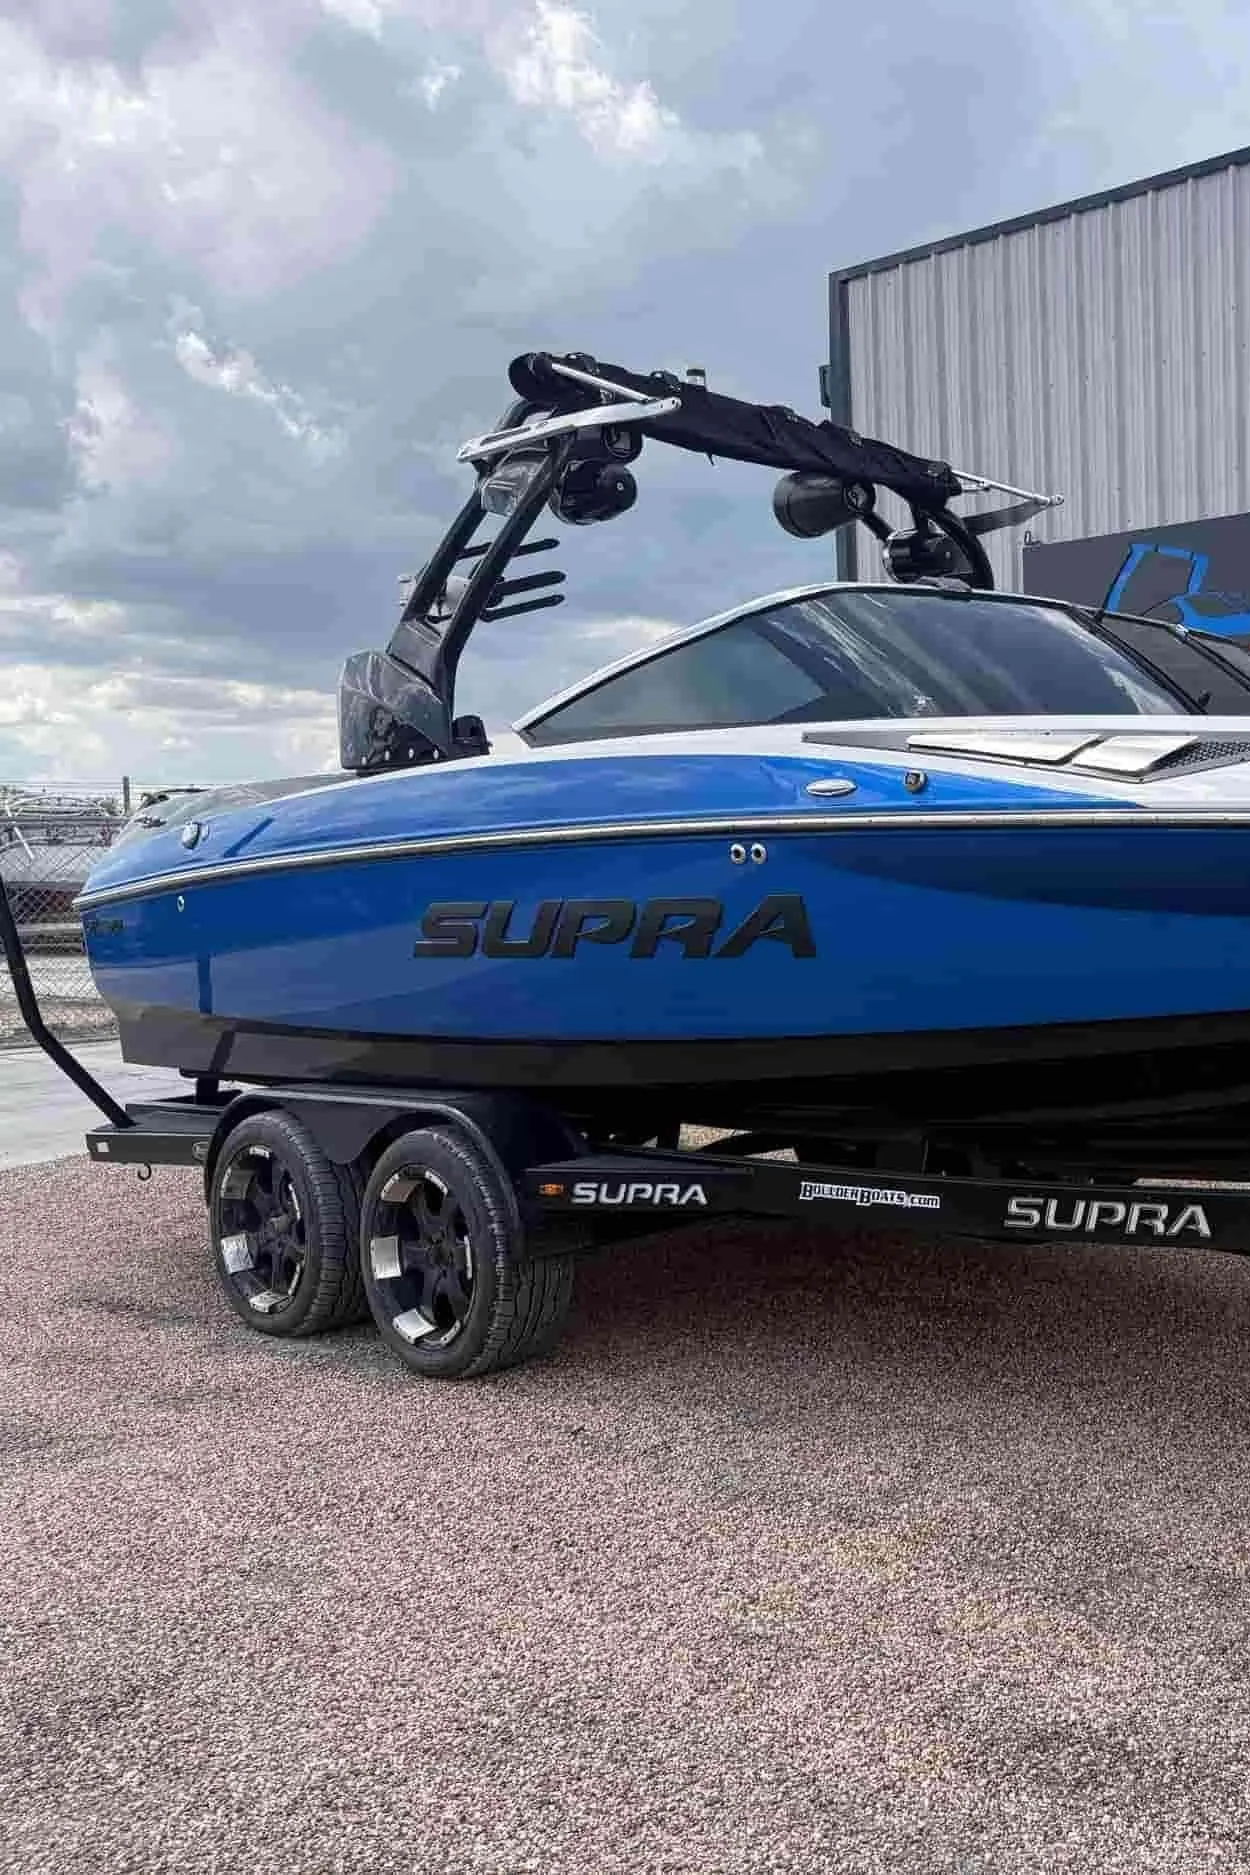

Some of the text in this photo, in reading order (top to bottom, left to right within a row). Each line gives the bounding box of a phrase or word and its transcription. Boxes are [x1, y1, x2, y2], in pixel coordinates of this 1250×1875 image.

[413, 895, 817, 960] SUPRA
[572, 1181, 708, 1206] SUPRA
[1004, 1197, 1214, 1238] SUPRA
